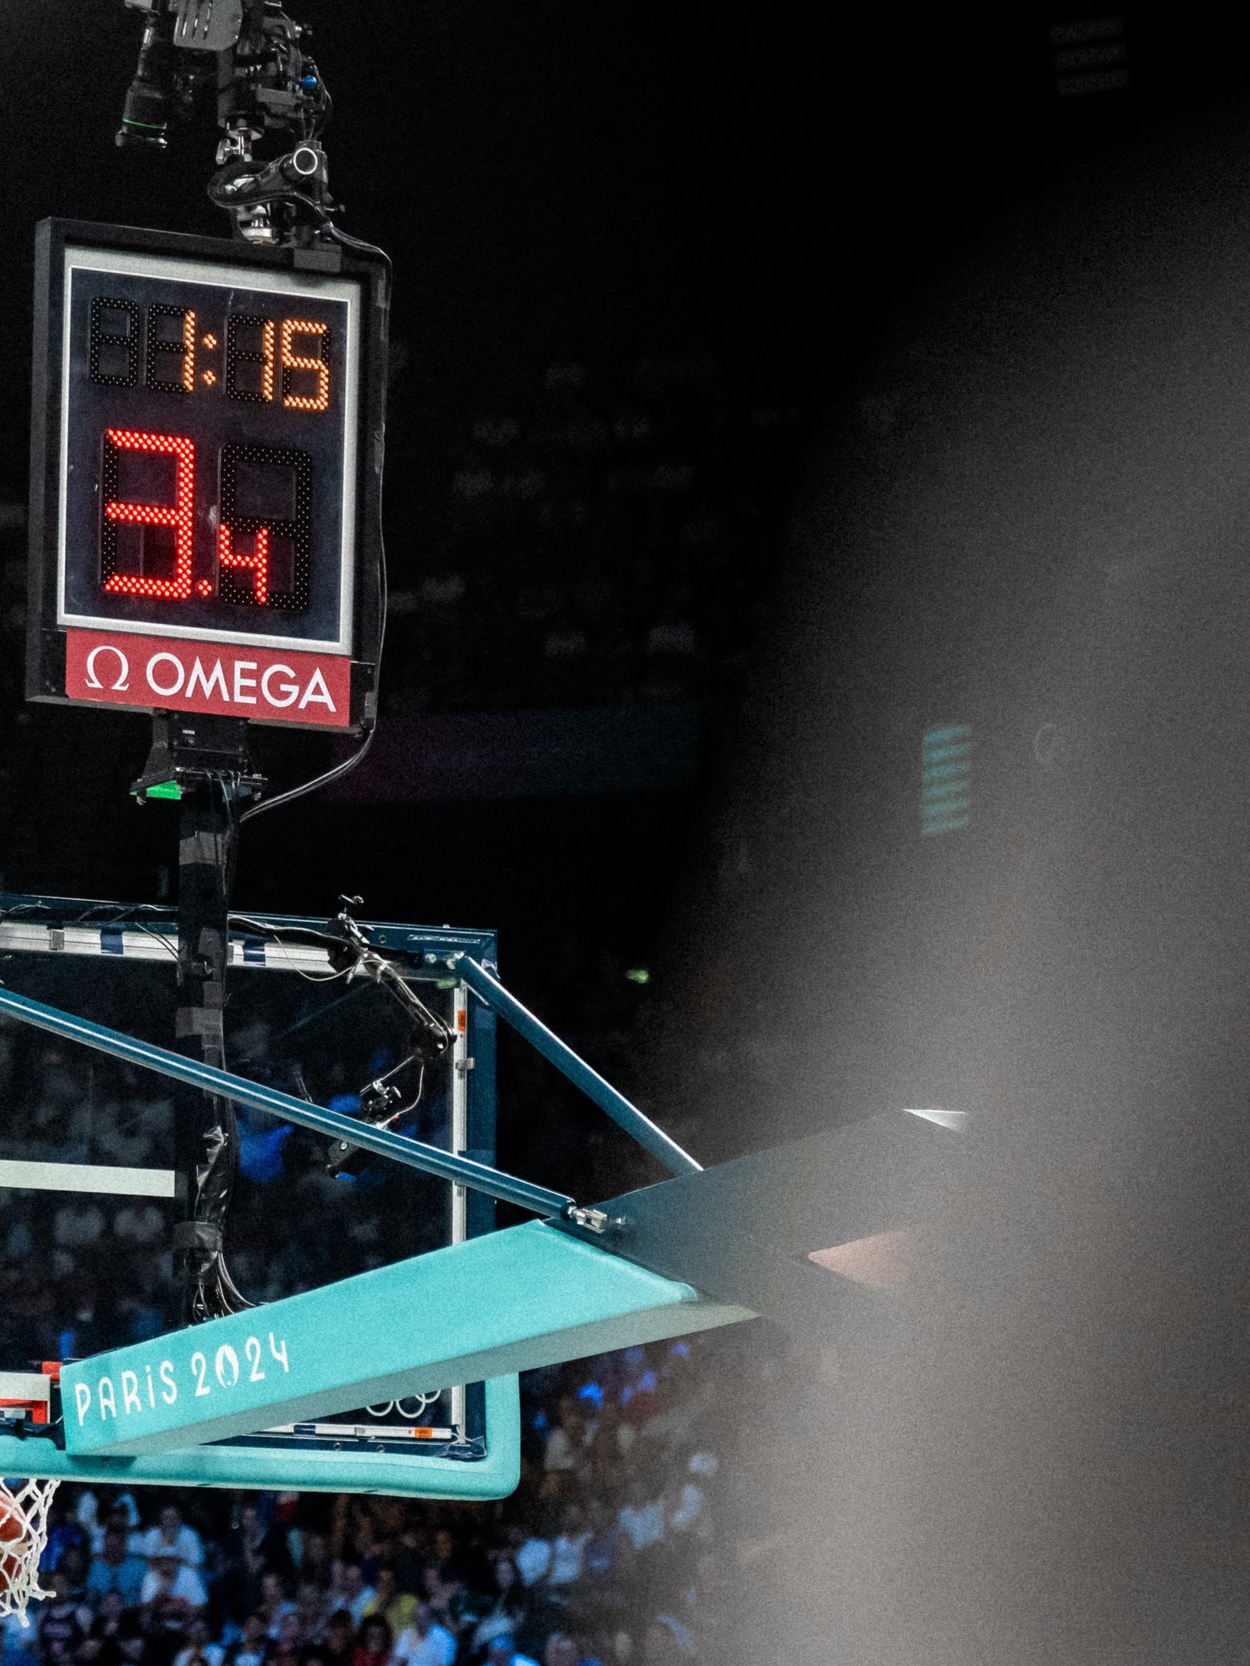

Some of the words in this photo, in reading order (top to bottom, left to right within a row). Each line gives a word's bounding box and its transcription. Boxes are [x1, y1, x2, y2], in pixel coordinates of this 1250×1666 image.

[184, 309, 330, 411] 1:15
[104, 428, 269, 604] 3.4
[146, 652, 337, 713] OMEGA
[190, 1332, 289, 1397] 2024
